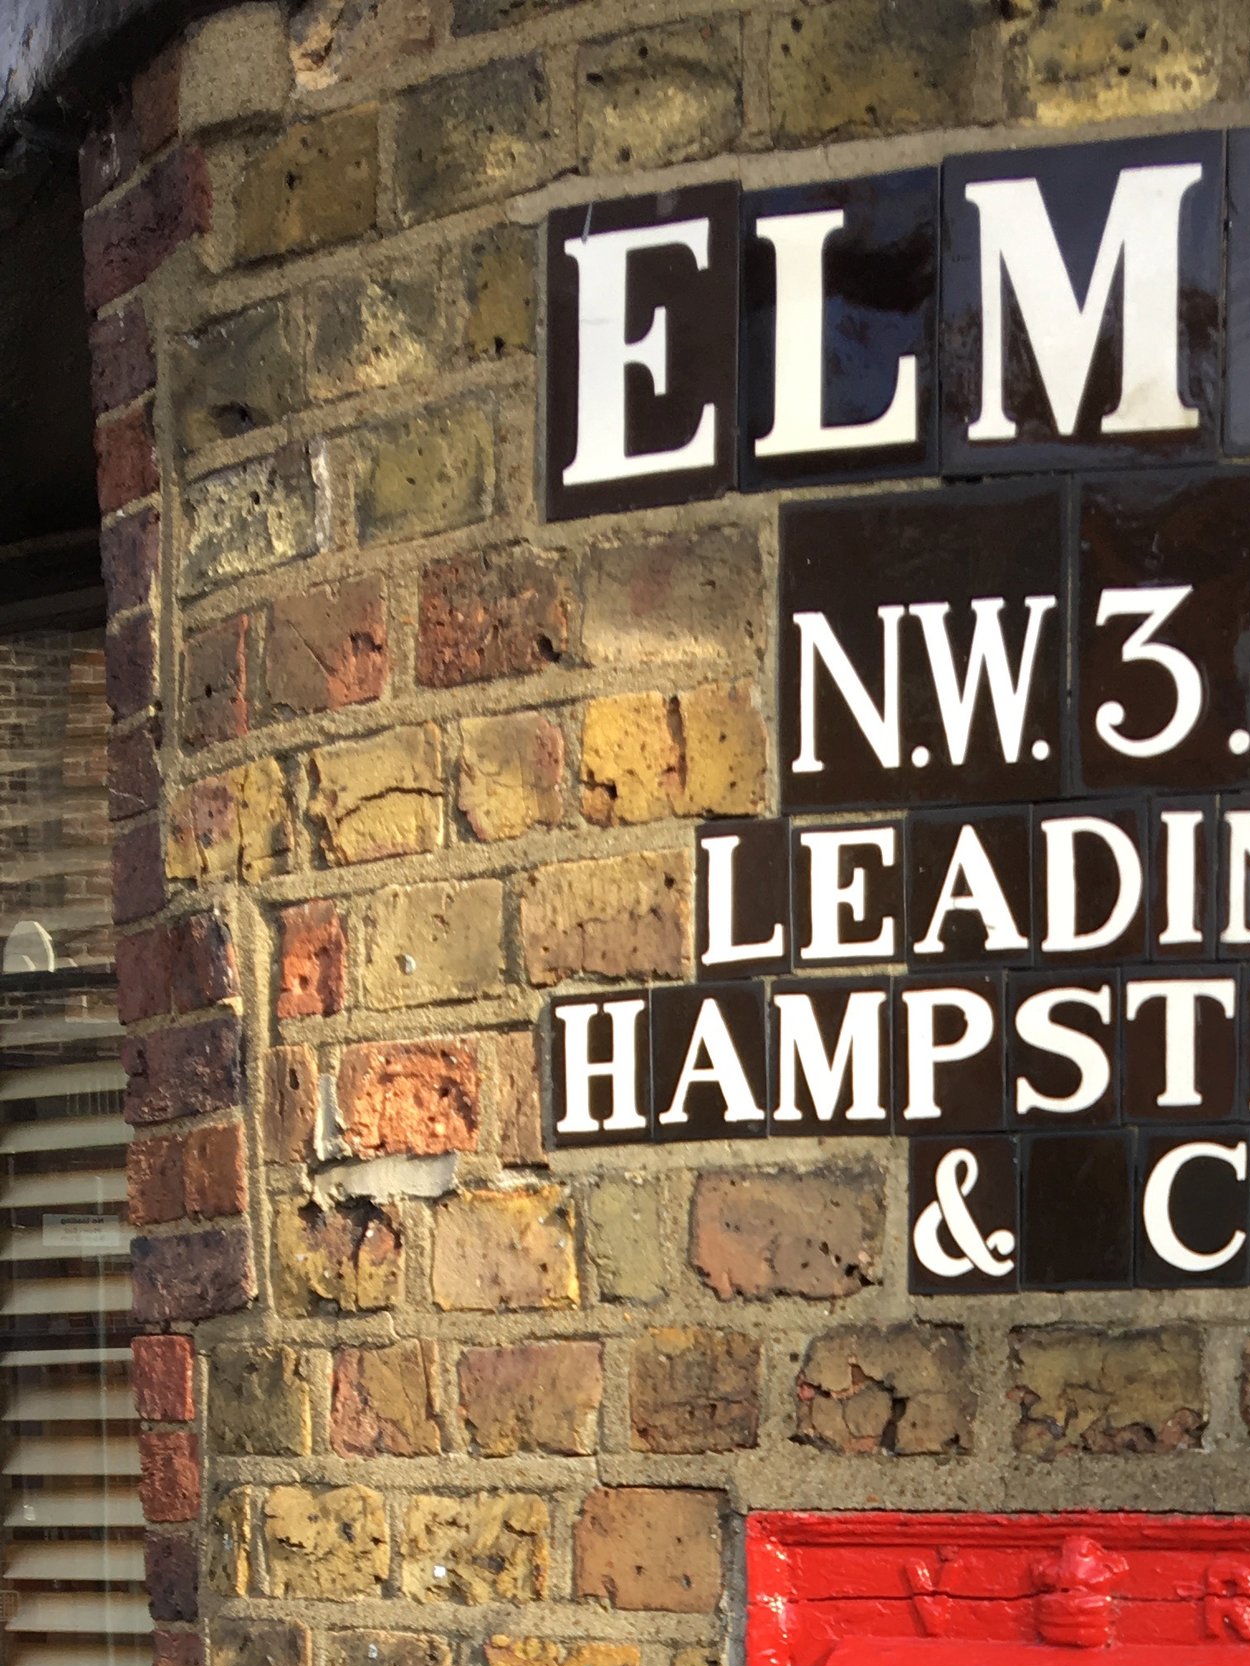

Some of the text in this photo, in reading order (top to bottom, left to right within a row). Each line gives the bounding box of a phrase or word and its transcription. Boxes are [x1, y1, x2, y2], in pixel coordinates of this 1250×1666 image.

[562, 164, 1202, 486] ELM
[792, 595, 1056, 773] N.W.
[914, 1148, 1015, 1276] &
